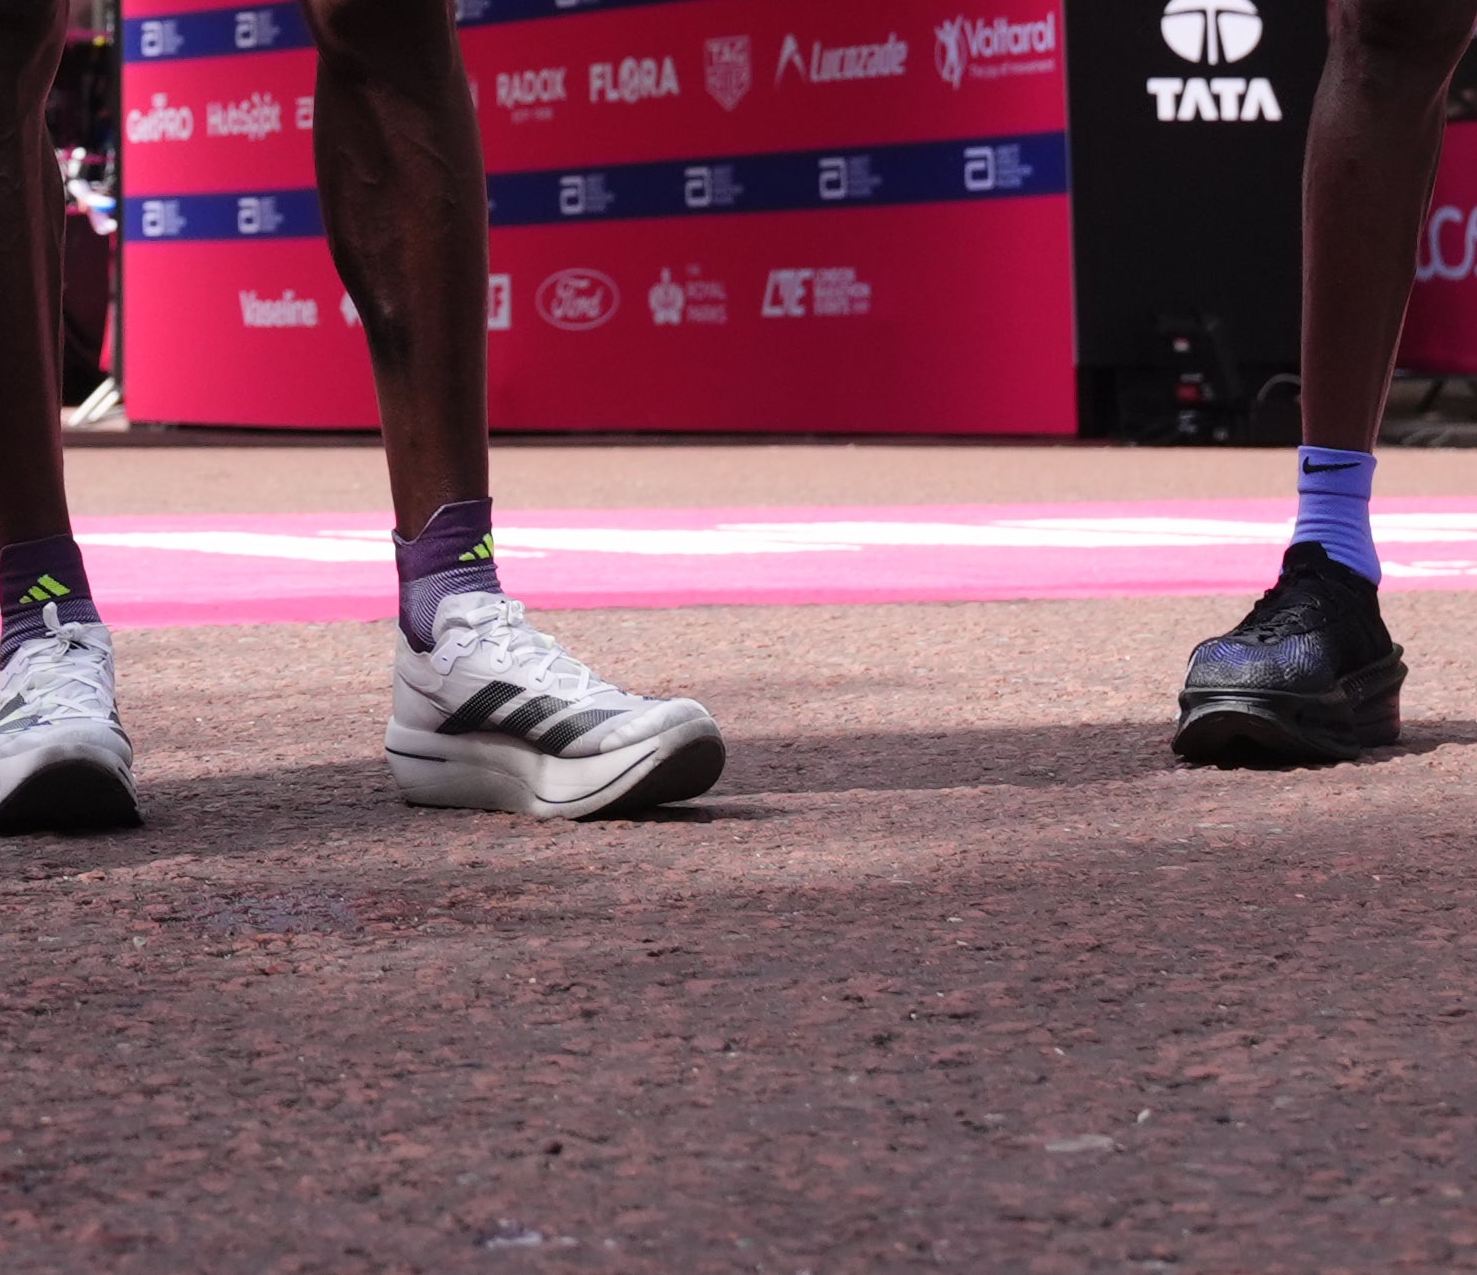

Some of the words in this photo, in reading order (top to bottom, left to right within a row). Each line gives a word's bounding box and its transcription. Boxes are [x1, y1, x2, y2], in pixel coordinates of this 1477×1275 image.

[496, 66, 567, 108] RADOX
[588, 55, 681, 105] FLORA
[809, 32, 908, 85] Lucozade
[964, 11, 1056, 59] Voltarol
[1146, 76, 1283, 122] TATA
[239, 289, 319, 329] Vaseline
